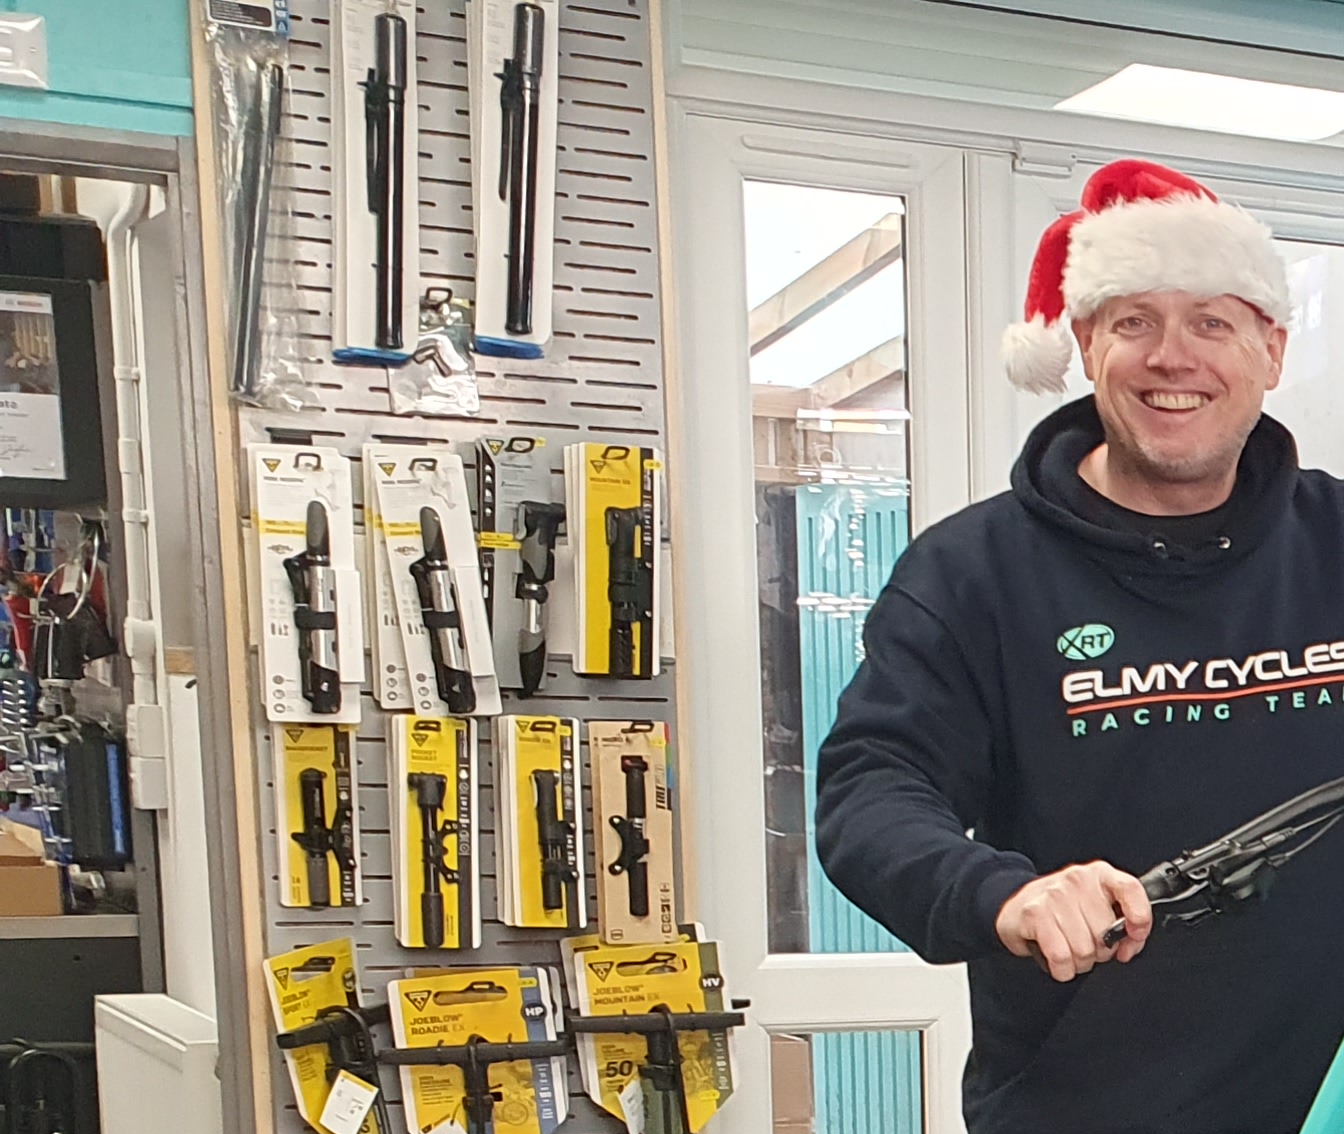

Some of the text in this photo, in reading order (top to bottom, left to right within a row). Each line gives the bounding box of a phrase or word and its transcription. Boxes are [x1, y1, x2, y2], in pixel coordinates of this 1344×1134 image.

[1062, 661, 1198, 703] ELMY
[1072, 703, 1230, 737] RACING
[702, 976, 721, 989] HV
[525, 1006, 544, 1017] HP
[409, 1014, 460, 1026] JOEBLOW
[605, 1060, 633, 1077] 50
